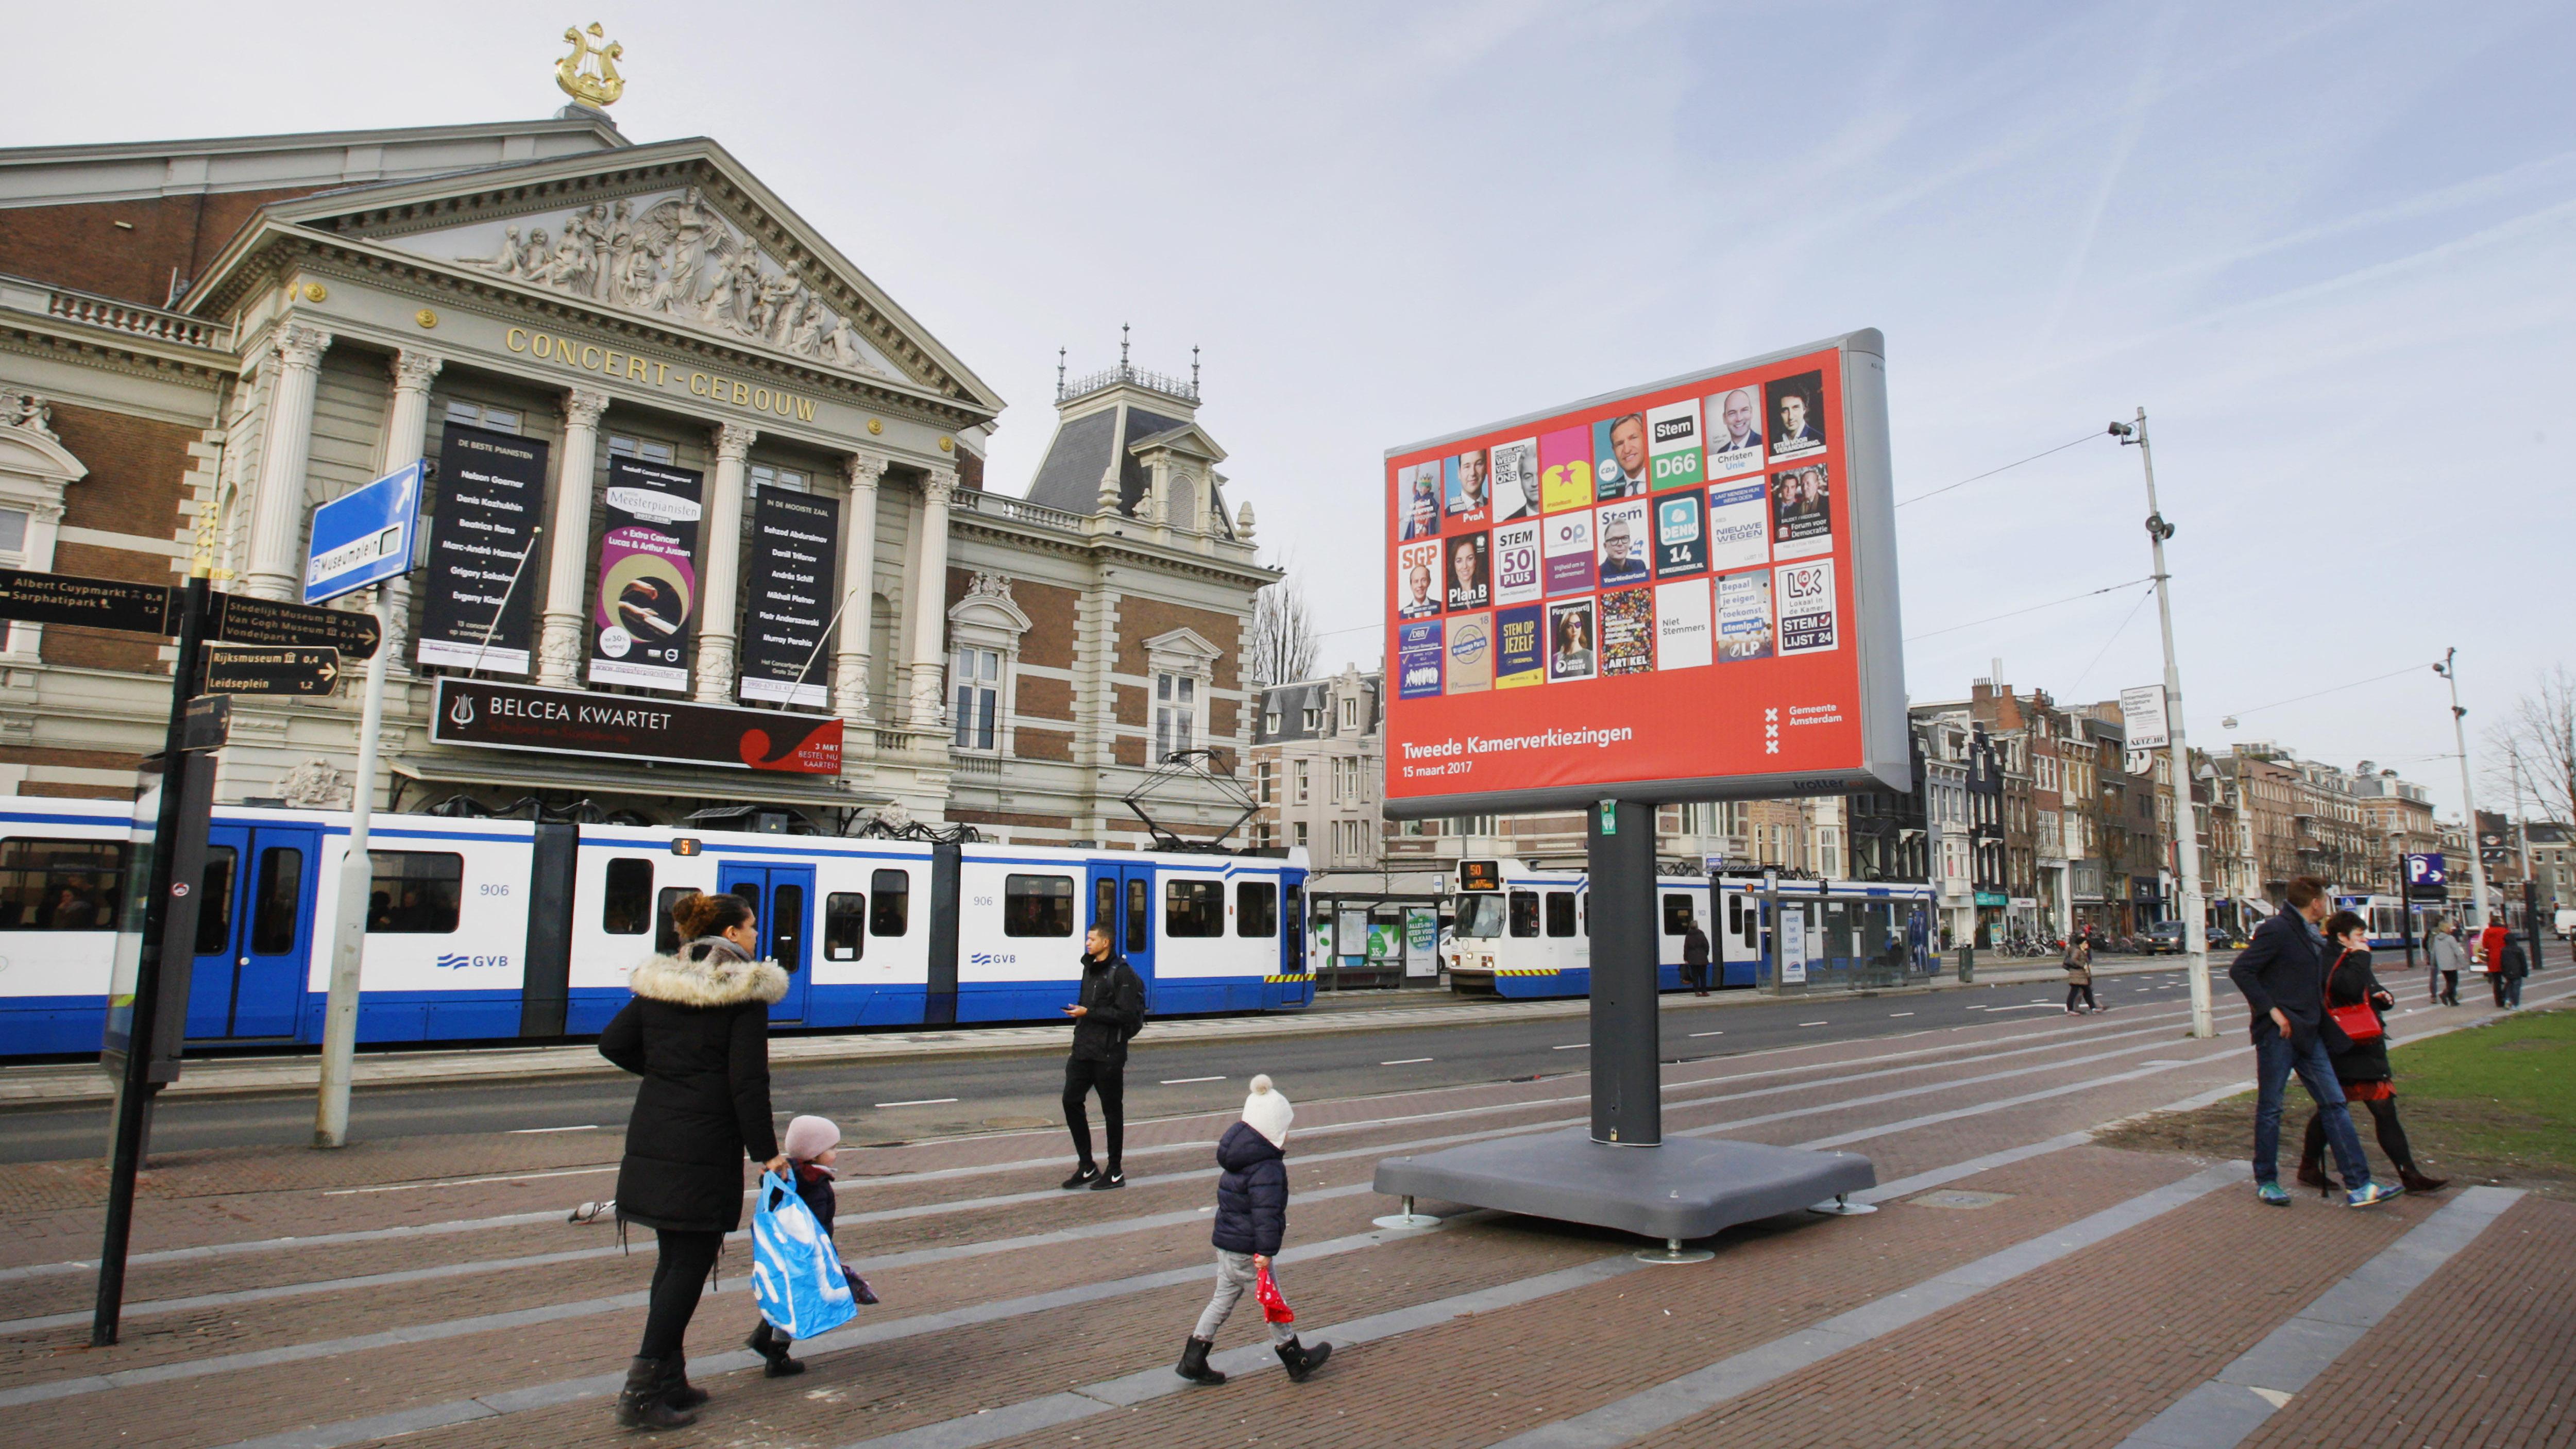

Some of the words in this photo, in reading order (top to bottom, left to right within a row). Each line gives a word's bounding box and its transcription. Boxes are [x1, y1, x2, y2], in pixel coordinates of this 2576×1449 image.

[1656, 422, 1690, 437] Stem
[458, 439, 469, 447] DE
[471, 442, 493, 452] BESTE
[495, 446, 533, 460] PIANISTEN
[1495, 446, 1525, 457] NEDERLAND
[1496, 455, 1516, 464] WEER
[1718, 451, 1753, 464] Christen
[1497, 465, 1510, 473] VAN
[1601, 466, 1615, 475] CDA
[1656, 453, 1696, 478] D66
[1726, 461, 1745, 470] Unie
[461, 470, 489, 482] Nelson
[1497, 472, 1516, 483] ONS
[456, 494, 480, 505] Denis
[481, 498, 523, 512] Kozhukhin
[610, 491, 697, 517] Meesterpianisten
[785, 503, 812, 514] MOOISTE
[814, 508, 828, 517] ZAAL
[1602, 509, 1642, 525] Stem
[459, 519, 493, 531] Beatrice
[495, 525, 515, 535] Rana
[764, 526, 789, 536] Behzod
[1663, 523, 1696, 540] DENK
[1716, 522, 1761, 535] NIEUWE
[1791, 521, 1811, 530] Forum
[1792, 526, 1827, 538] Democratie
[630, 530, 649, 541] Extra
[650, 533, 680, 545] Concert
[1500, 530, 1533, 546] STEM
[1717, 529, 1762, 543] WEGEN
[608, 536, 630, 547] Lucas
[632, 540, 638, 549] &
[640, 543, 664, 553] Arthur
[666, 546, 690, 557] Jussen
[321, 540, 378, 571] Museumplein
[792, 552, 817, 562] Trifonov
[1402, 545, 1437, 569] SGP
[1503, 549, 1530, 572] 50
[1670, 545, 1691, 563] 14
[450, 566, 481, 579] Grigory
[796, 574, 814, 583] Schiff
[1504, 572, 1530, 585] PLUS
[1603, 572, 1646, 583] VoorNederland
[13, 578, 55, 590] Albert
[59, 583, 127, 598] Cuypmarkt
[1722, 581, 1750, 592] Bepaal
[11, 591, 96, 608] Sarphatipark
[453, 592, 482, 603] Evgeny
[1449, 587, 1476, 603] Plan
[1478, 584, 1487, 598] B
[1732, 595, 1755, 604] eigen
[143, 606, 159, 614] 1,2
[229, 602, 278, 617] Stedelijk
[280, 610, 324, 623] Museum
[1552, 603, 1590, 616] Piratenpartij
[1723, 606, 1764, 618] toekomst.
[1800, 605, 1823, 613] Kamer
[228, 614, 248, 625] Van
[251, 618, 278, 629] Gogh
[282, 621, 325, 635] Museum
[1480, 616, 1489, 624] 18
[1663, 618, 1680, 627] Niet
[1723, 621, 1762, 632] stemlp.nl
[1784, 617, 1817, 632] STEM
[226, 627, 286, 642] Vondelpark
[1503, 622, 1522, 637] STEM
[1524, 620, 1534, 634] OP
[1663, 624, 1705, 635] Stemmers
[763, 634, 787, 645] Murray
[1504, 634, 1534, 654] JEZELF
[1785, 634, 1815, 647] LIJST
[1819, 632, 1832, 643] 24
[1741, 642, 1760, 656] LP
[213, 652, 282, 665] Rijksmuseum
[302, 655, 319, 664] 0,4
[209, 678, 269, 690] Leidseplein
[299, 681, 314, 689] 1,2
[490, 697, 571, 721] BELCEA
[579, 705, 671, 730] KWARTET
[1789, 704, 1837, 715] Gemeente
[1789, 714, 1842, 726] Amsterdam
[1402, 738, 1462, 759] Tweede
[1467, 727, 1632, 753] Kamerverkiezingen
[799, 750, 823, 759] BESTEL
[804, 761, 837, 769] KAARTEN
[1402, 766, 1413, 778] 15
[1416, 765, 1445, 777] maart
[1447, 761, 1472, 774] 2017
[1793, 779, 1844, 789] trotter
[2410, 860, 2427, 882] P
[480, 884, 509, 896] 906
[974, 896, 993, 906] 906
[473, 956, 507, 967] GVB
[993, 954, 1015, 963] GVB
